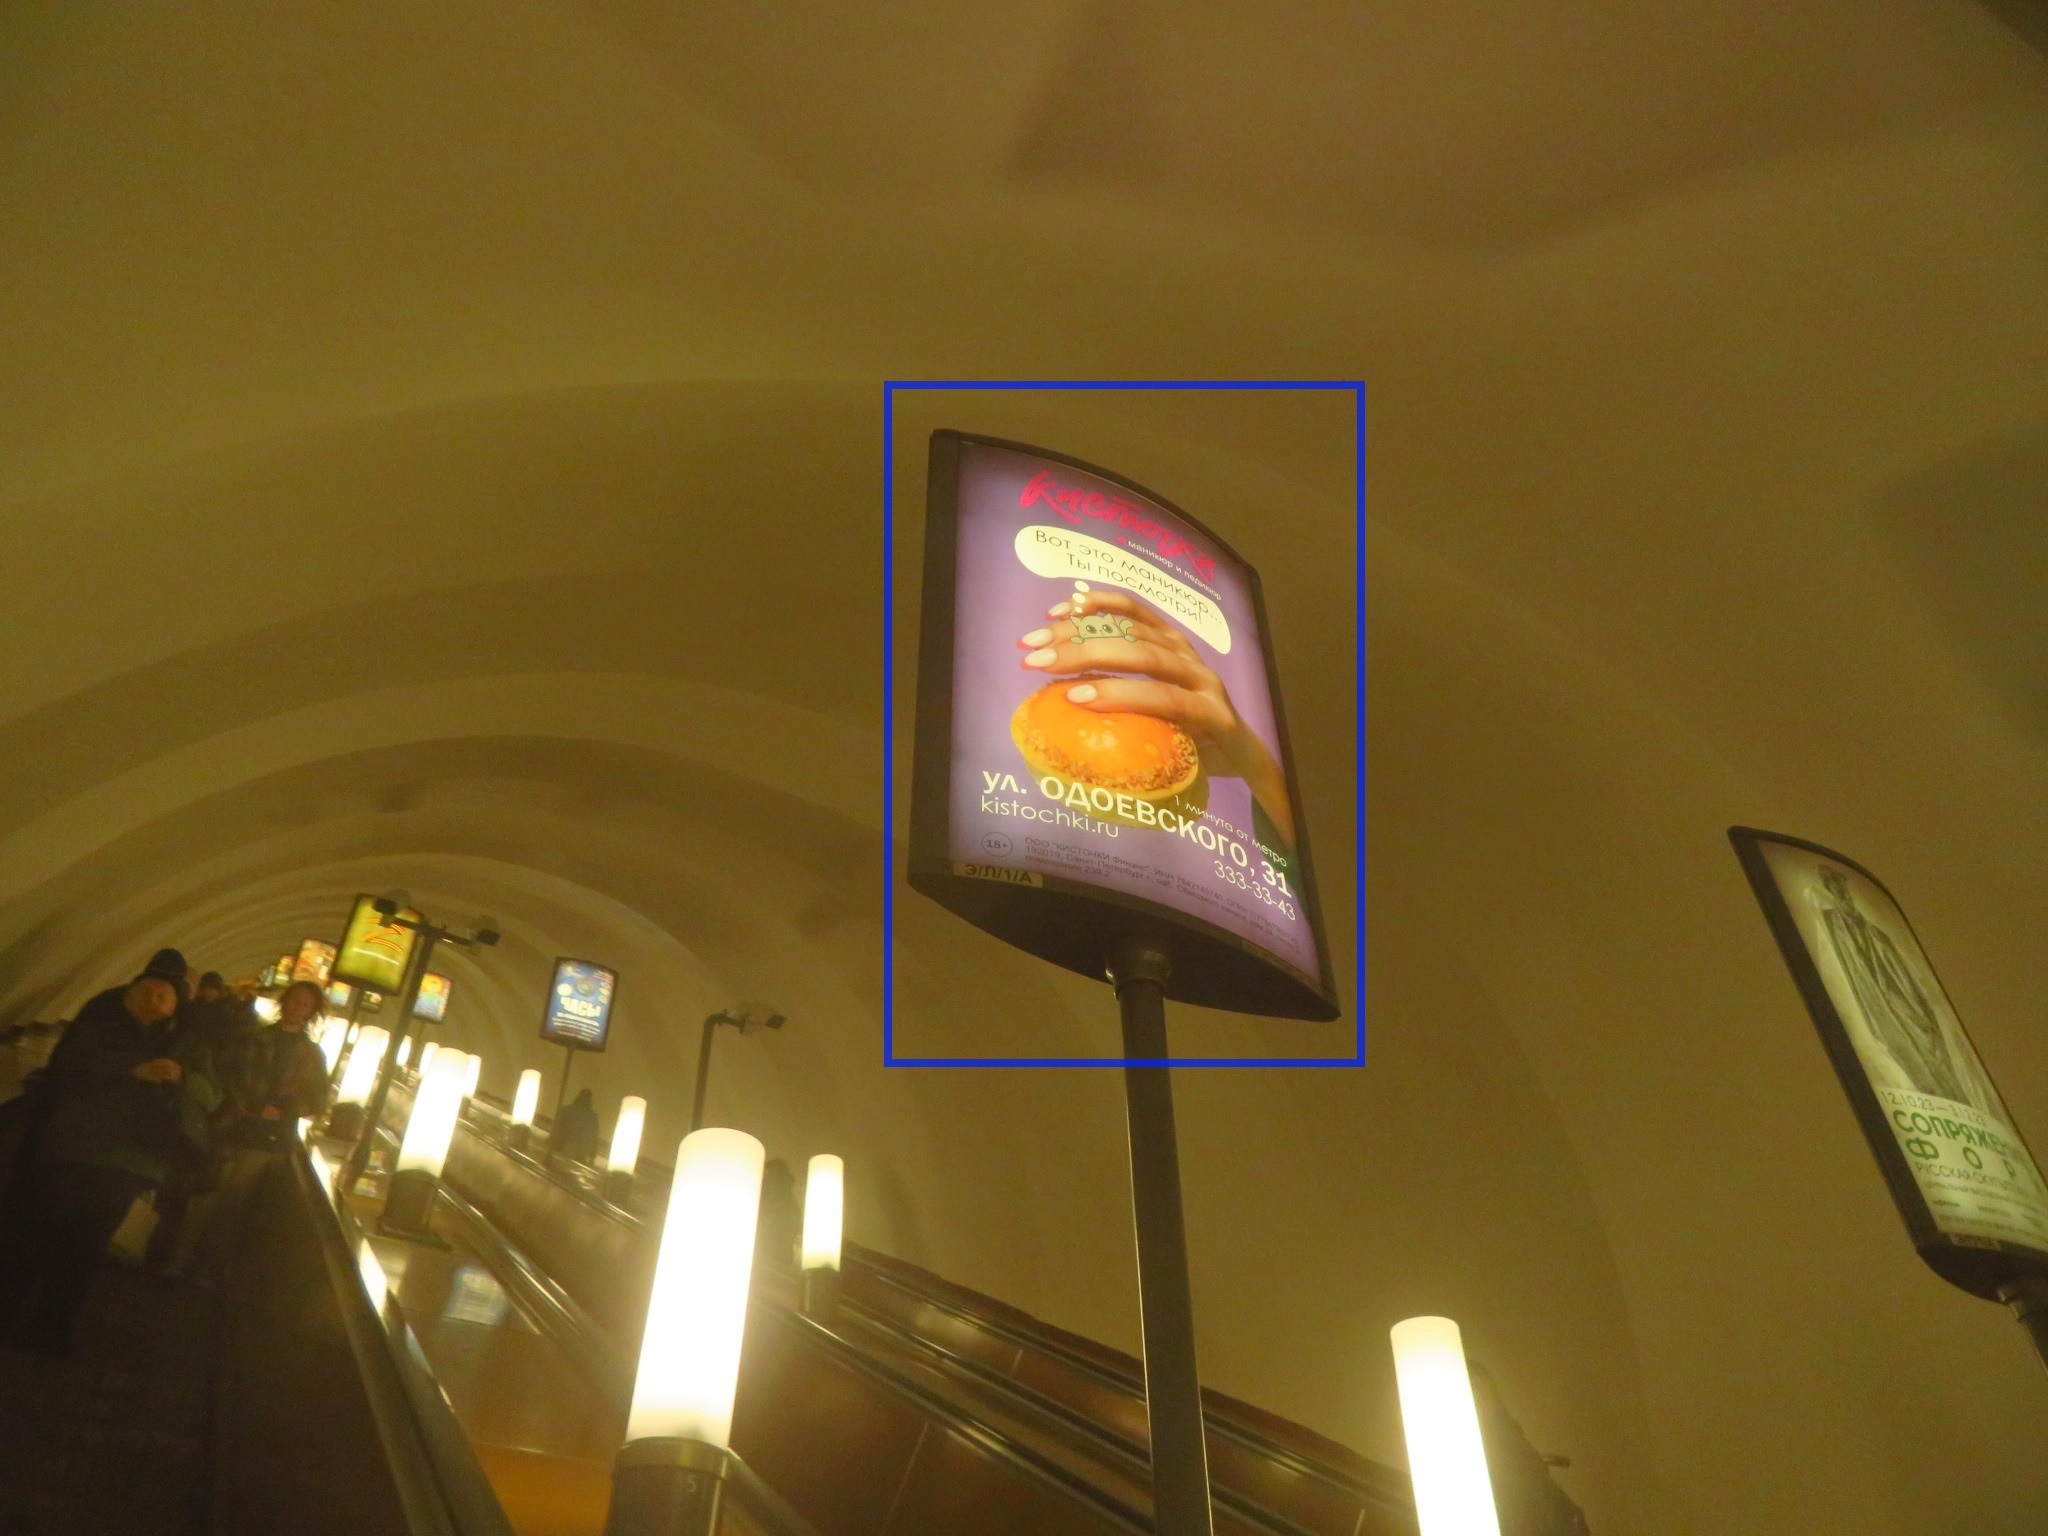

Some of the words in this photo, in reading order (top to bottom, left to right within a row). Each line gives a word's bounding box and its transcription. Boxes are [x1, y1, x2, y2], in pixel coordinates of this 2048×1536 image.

[1035, 529, 1071, 550] Вот
[1078, 543, 1114, 564] это
[1120, 560, 1223, 625] маникюр...
[1066, 552, 1091, 572] Ты
[1098, 564, 1203, 625] посмотри!
[1127, 540, 1174, 568] маникюр
[1175, 565, 1182, 574] и
[1184, 570, 1222, 601] педикюр
[981, 795, 1120, 838] kistochki.ru
[982, 770, 1028, 795] ул.
[1260, 860, 1293, 899] 31
[986, 839, 1008, 849] 18+
[1024, 837, 1050, 848] ООО
[1185, 802, 1234, 834] минута
[1236, 829, 1249, 842] от
[1251, 839, 1288, 868] метро
[1213, 860, 1297, 921] 333-33-43
